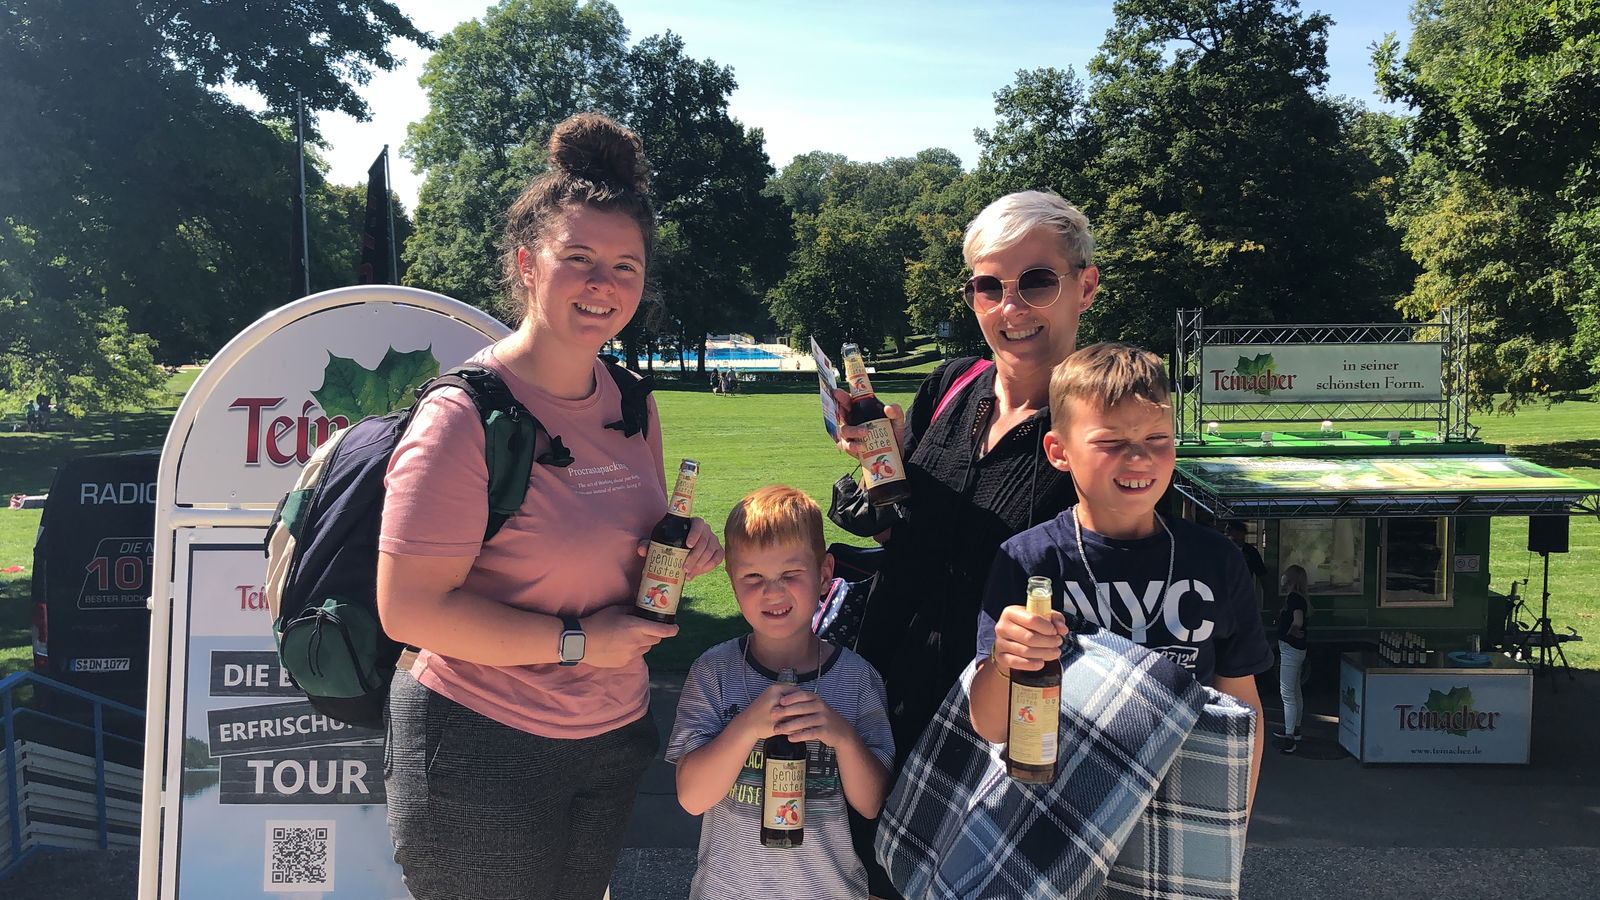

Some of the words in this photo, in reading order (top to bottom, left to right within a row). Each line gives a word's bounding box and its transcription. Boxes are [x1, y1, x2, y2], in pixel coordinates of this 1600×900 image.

[1343, 360, 1356, 371] in
[1360, 360, 1399, 371] seiner
[1210, 370, 1298, 391] Teinacher
[1316, 376, 1380, 390] schönsten
[1384, 377, 1425, 390] Form.
[120, 542, 142, 554] DIE
[651, 549, 683, 569] Genuss
[1063, 579, 1215, 643] NYC
[224, 664, 270, 687] DIE
[220, 714, 353, 742] ERFRISCHU
[1393, 704, 1501, 730] Teinacher
[247, 759, 370, 795] TOUR
